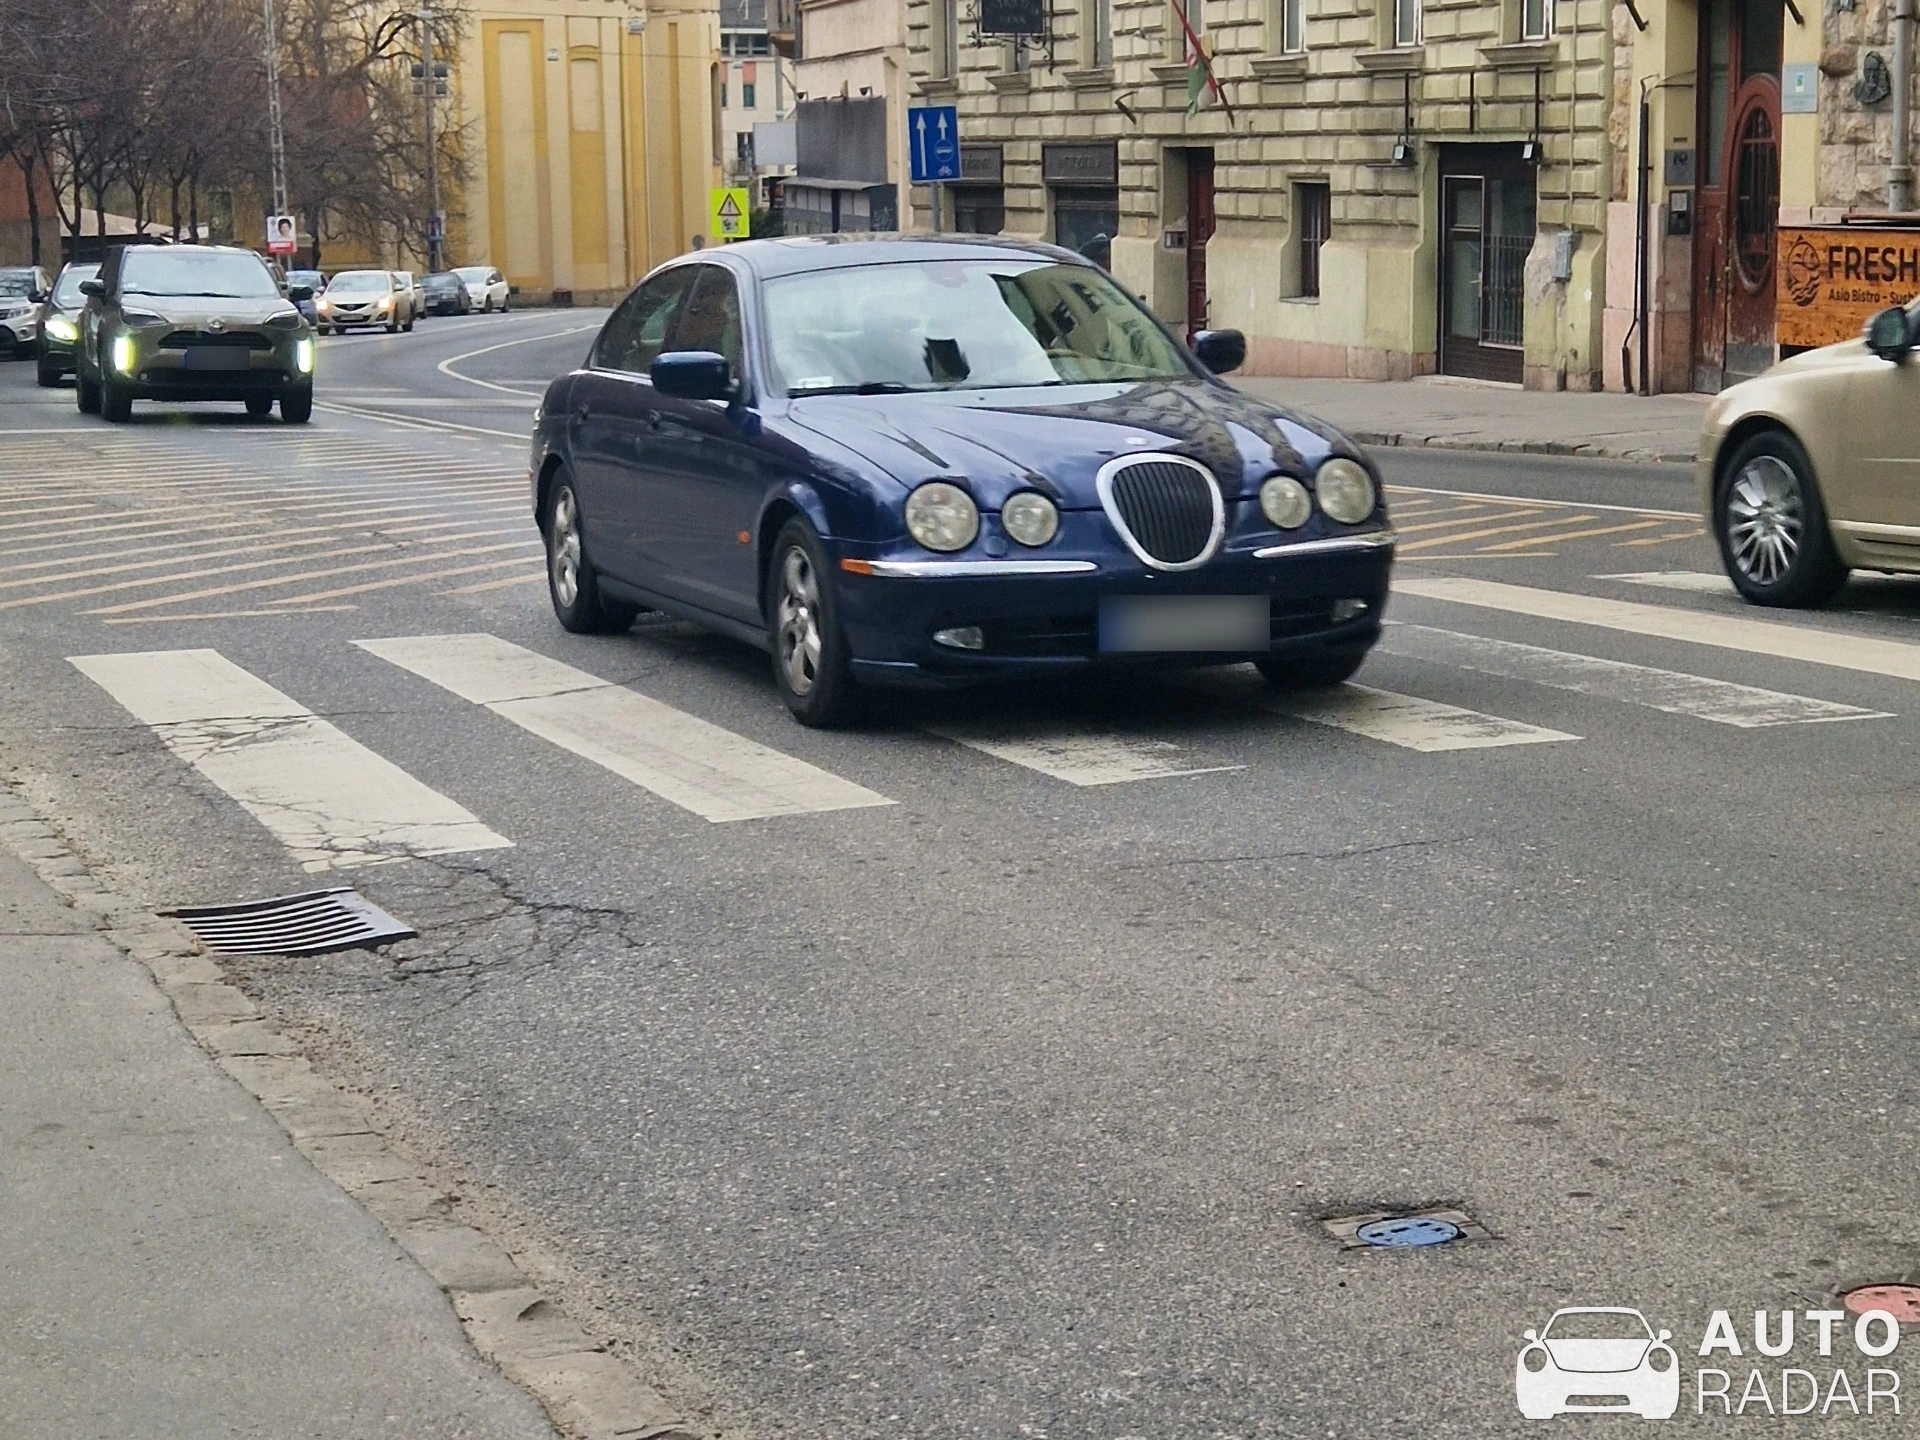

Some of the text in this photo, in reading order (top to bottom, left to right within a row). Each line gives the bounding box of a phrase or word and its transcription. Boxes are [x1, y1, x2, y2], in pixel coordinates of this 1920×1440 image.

[1828, 245, 1918, 283] FRESH
[1828, 288, 1850, 301] Asia
[1851, 289, 1880, 303] Bistro
[1889, 291, 1919, 305] Sush
